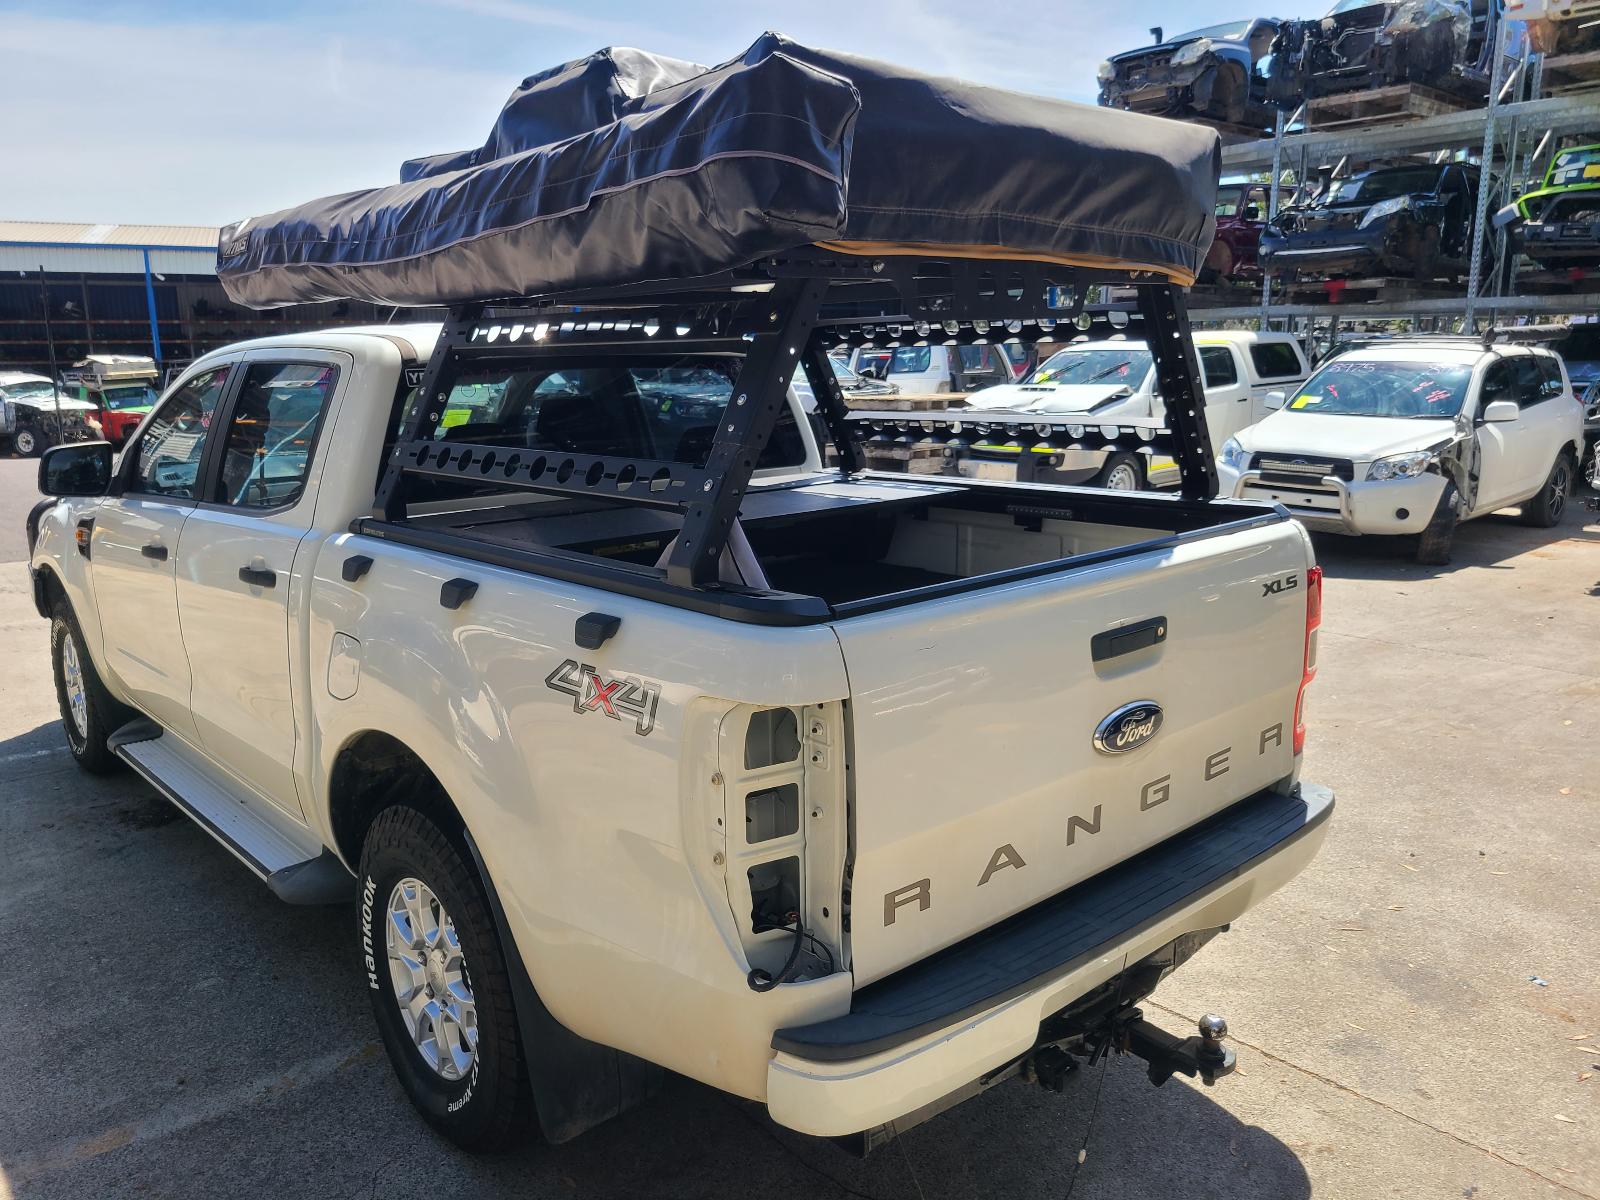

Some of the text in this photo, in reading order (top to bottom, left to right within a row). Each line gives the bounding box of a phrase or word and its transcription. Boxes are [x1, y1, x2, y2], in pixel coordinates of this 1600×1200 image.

[1262, 574, 1298, 597] XLS
[1115, 710, 1155, 747] Ford
[883, 721, 1283, 928] RANGER
